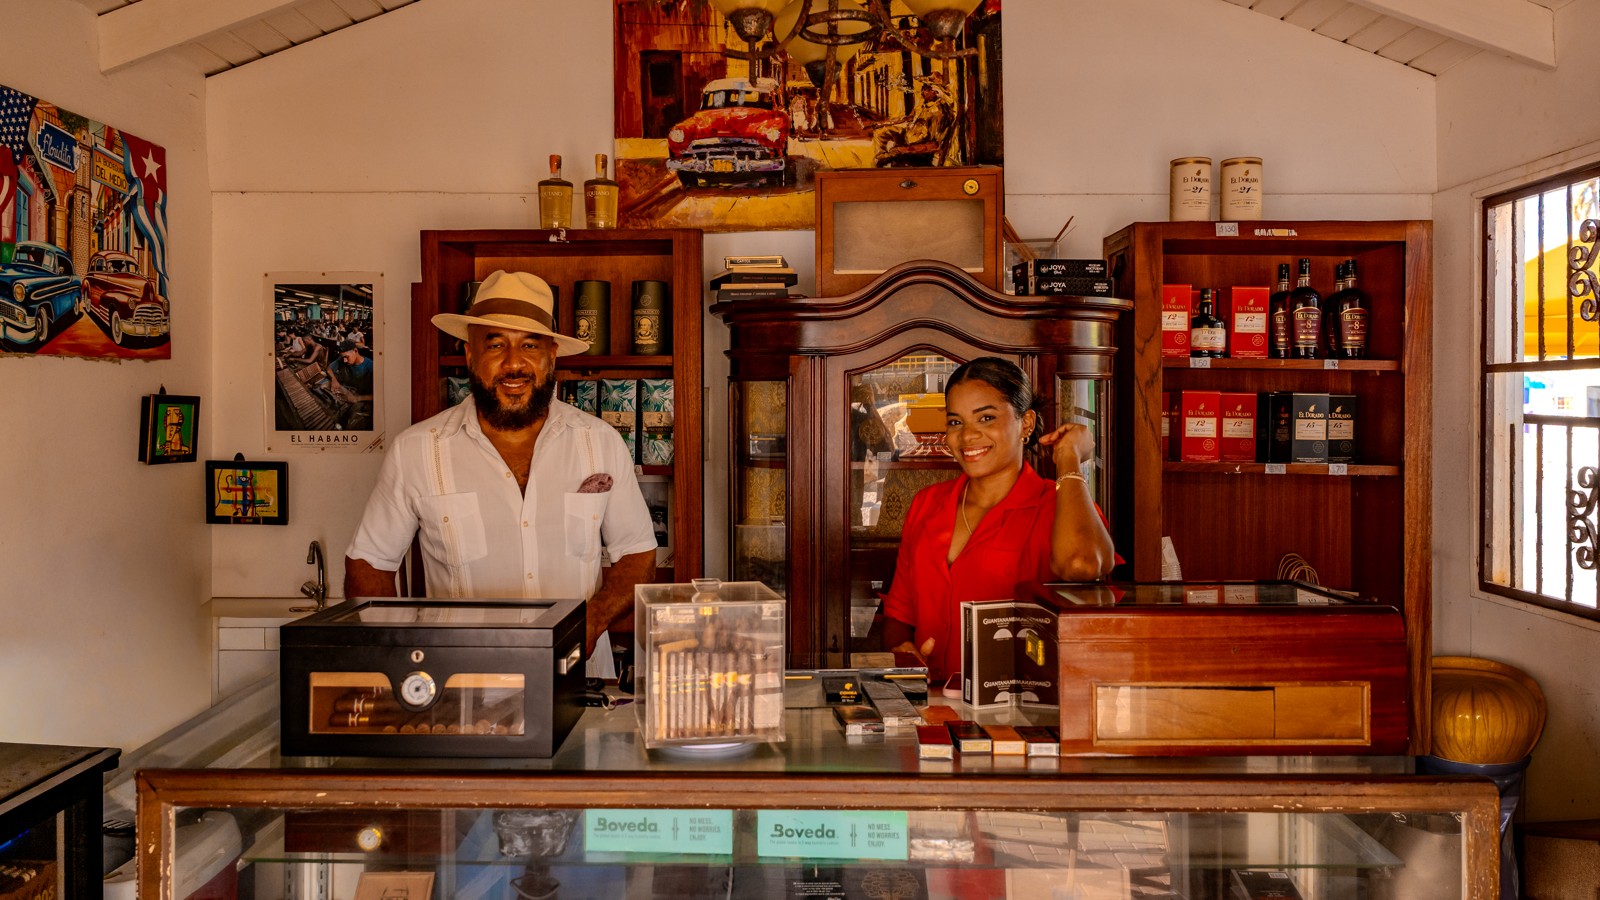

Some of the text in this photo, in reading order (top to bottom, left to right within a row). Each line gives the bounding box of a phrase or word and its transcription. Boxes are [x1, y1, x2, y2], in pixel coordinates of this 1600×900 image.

[43, 133, 71, 164] Floridita
[95, 164, 127, 190] DEL MEDIO
[1191, 186, 1203, 194] 21
[1239, 186, 1252, 194] 21
[1306, 320, 1312, 329] 8
[1354, 321, 1360, 330] 8
[1305, 411, 1325, 419] DORADO
[290, 434, 302, 443] EL
[309, 434, 359, 443] HABANO
[593, 817, 658, 833] Boveda
[868, 823, 875, 831] NO
[770, 823, 836, 839] Boveda
